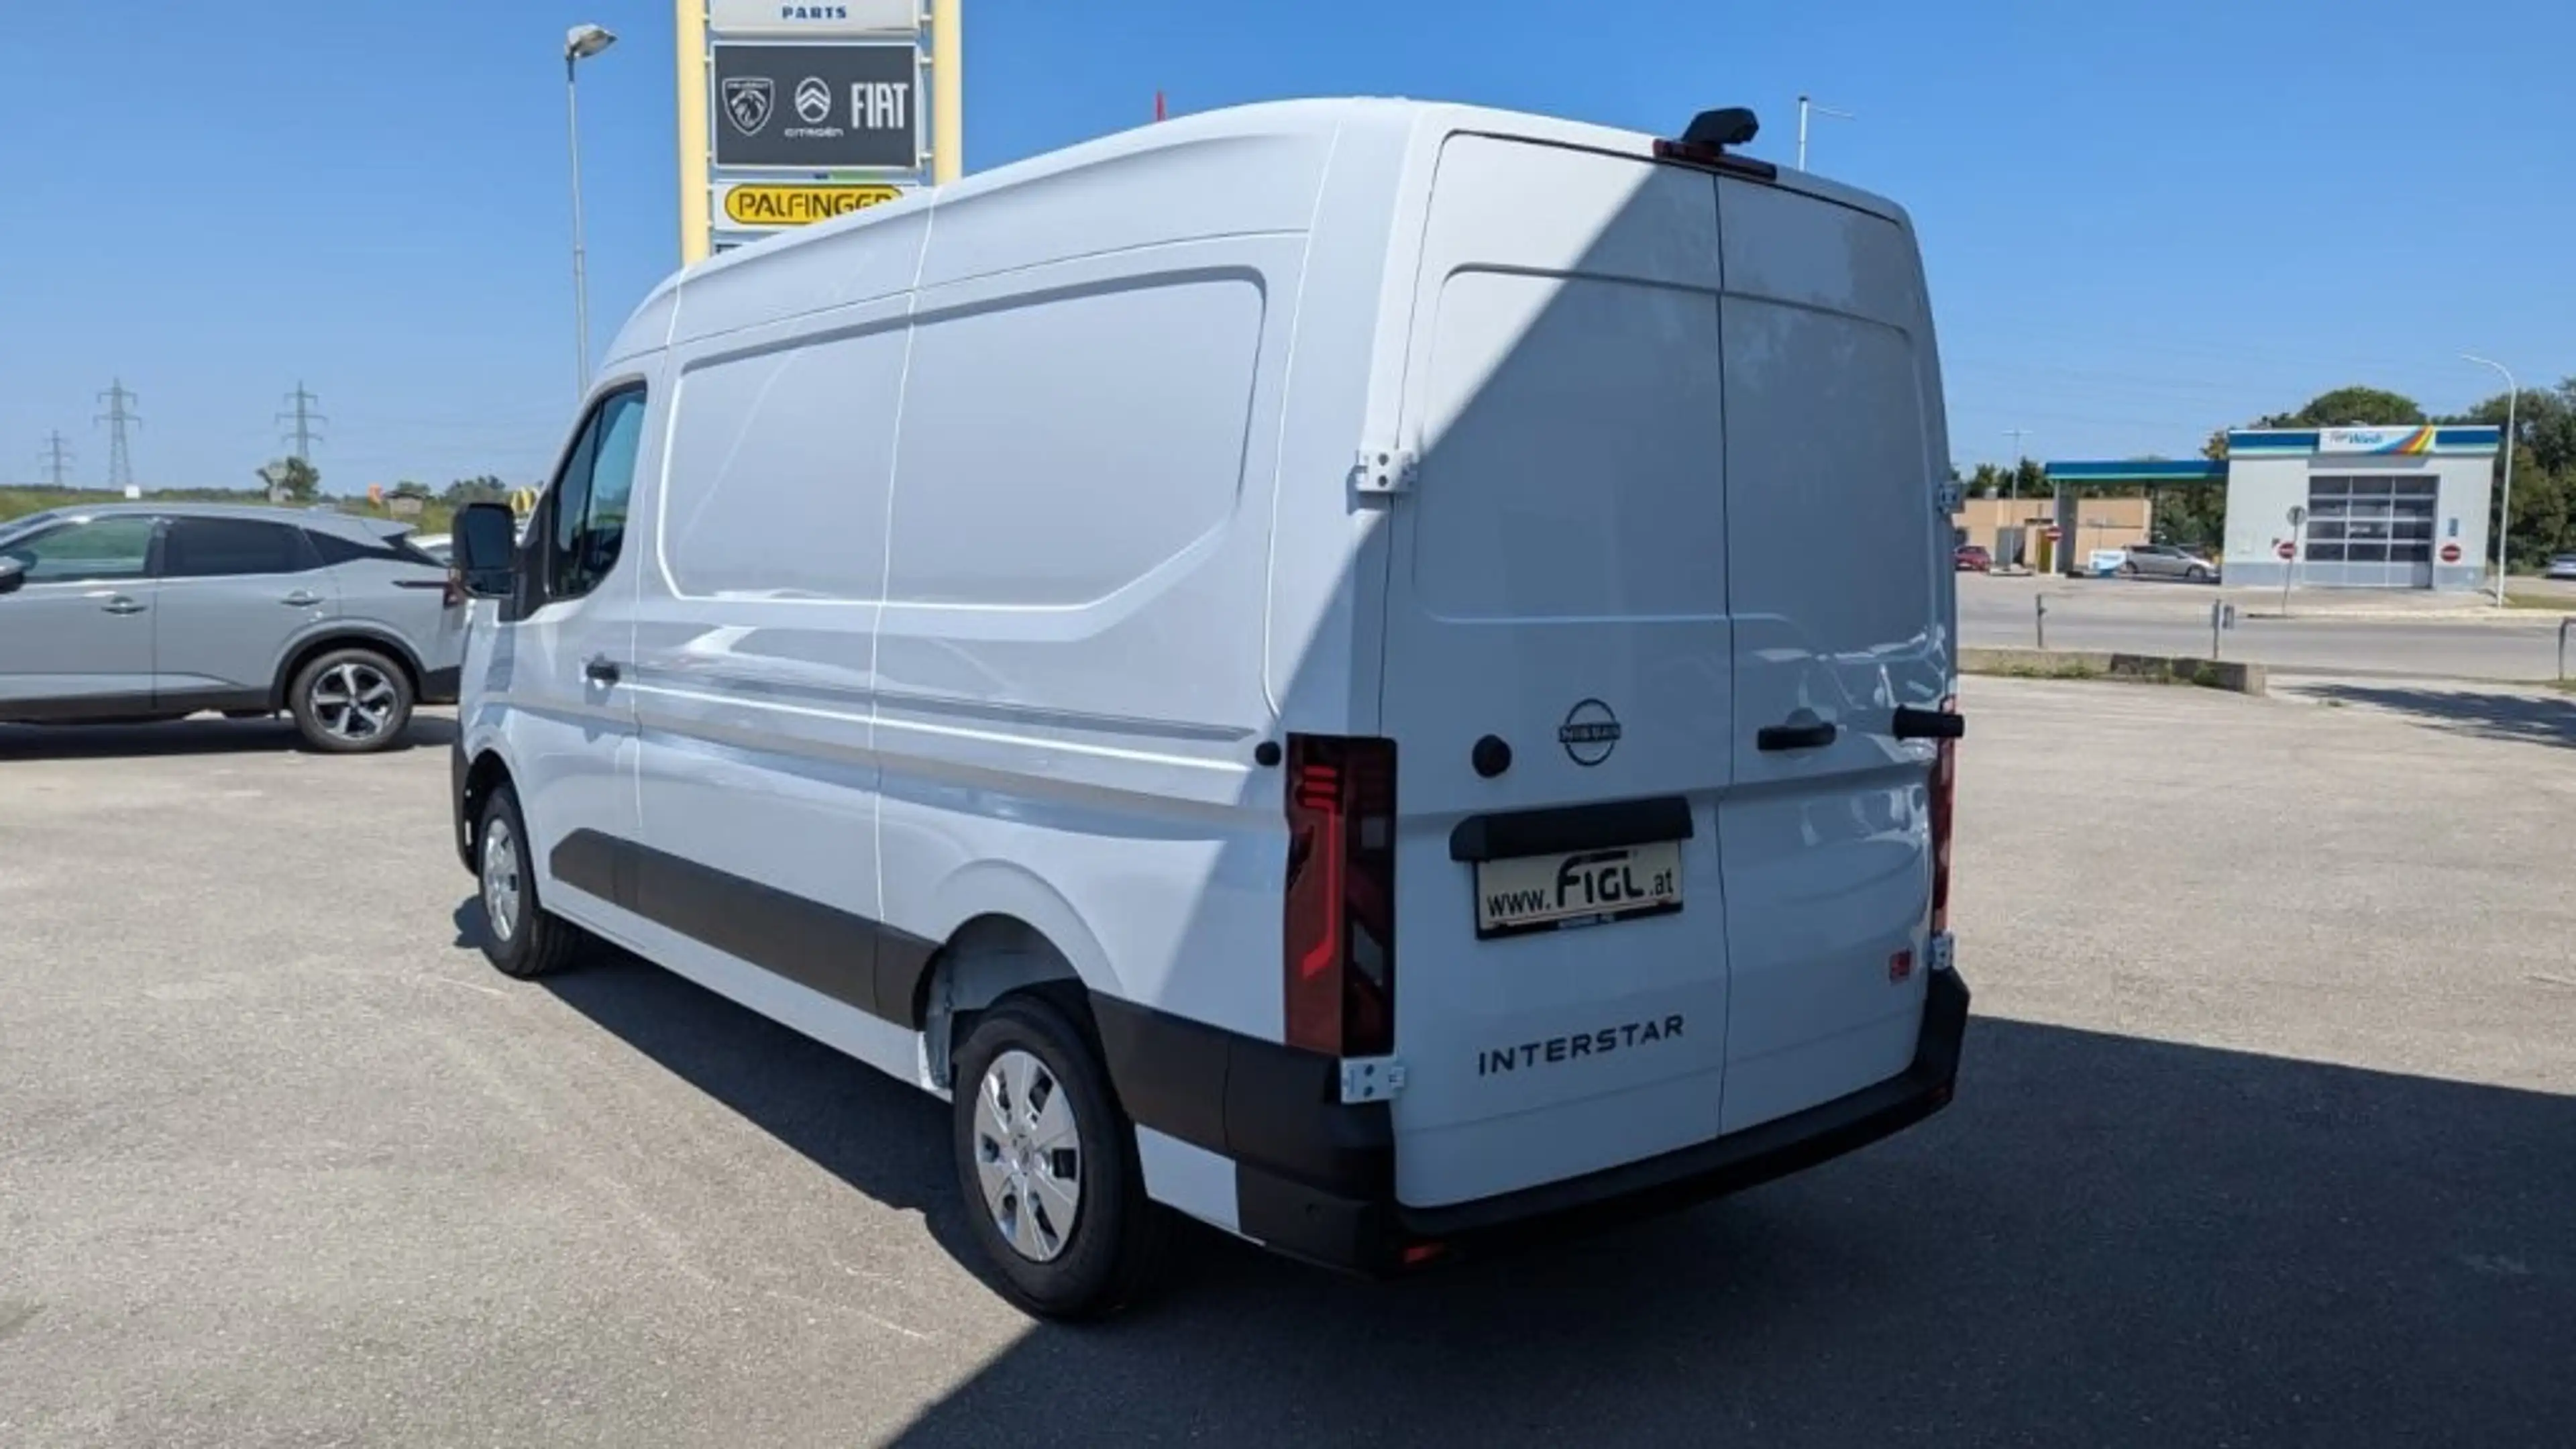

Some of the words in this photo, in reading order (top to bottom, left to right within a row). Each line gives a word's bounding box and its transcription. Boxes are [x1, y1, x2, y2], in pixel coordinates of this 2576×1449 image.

[782, 6, 847, 19] PARTS
[851, 83, 909, 129] FIAT
[1479, 1014, 1684, 1076] INTERSTAR
